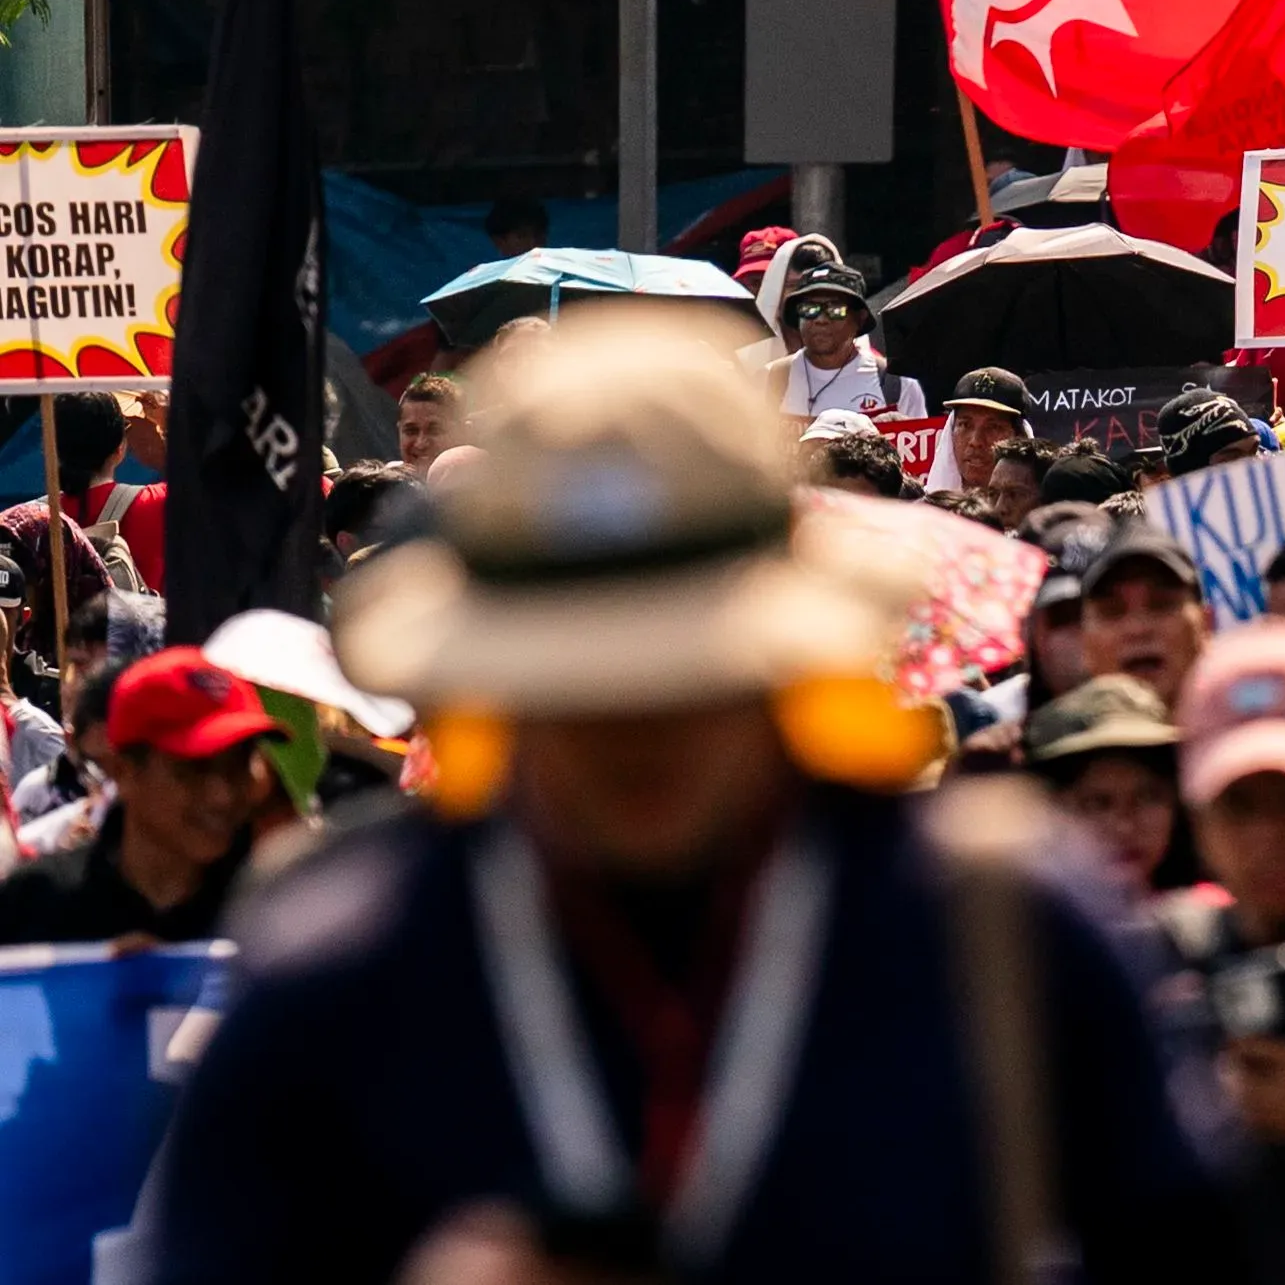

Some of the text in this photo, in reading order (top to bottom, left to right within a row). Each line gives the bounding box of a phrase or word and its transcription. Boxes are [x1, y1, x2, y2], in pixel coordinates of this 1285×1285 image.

[69, 200, 148, 235] HARI
[6, 242, 122, 280] KORAP,
[0, 283, 137, 320] AGUTIN!
[1028, 386, 1137, 412] MATAKOT
